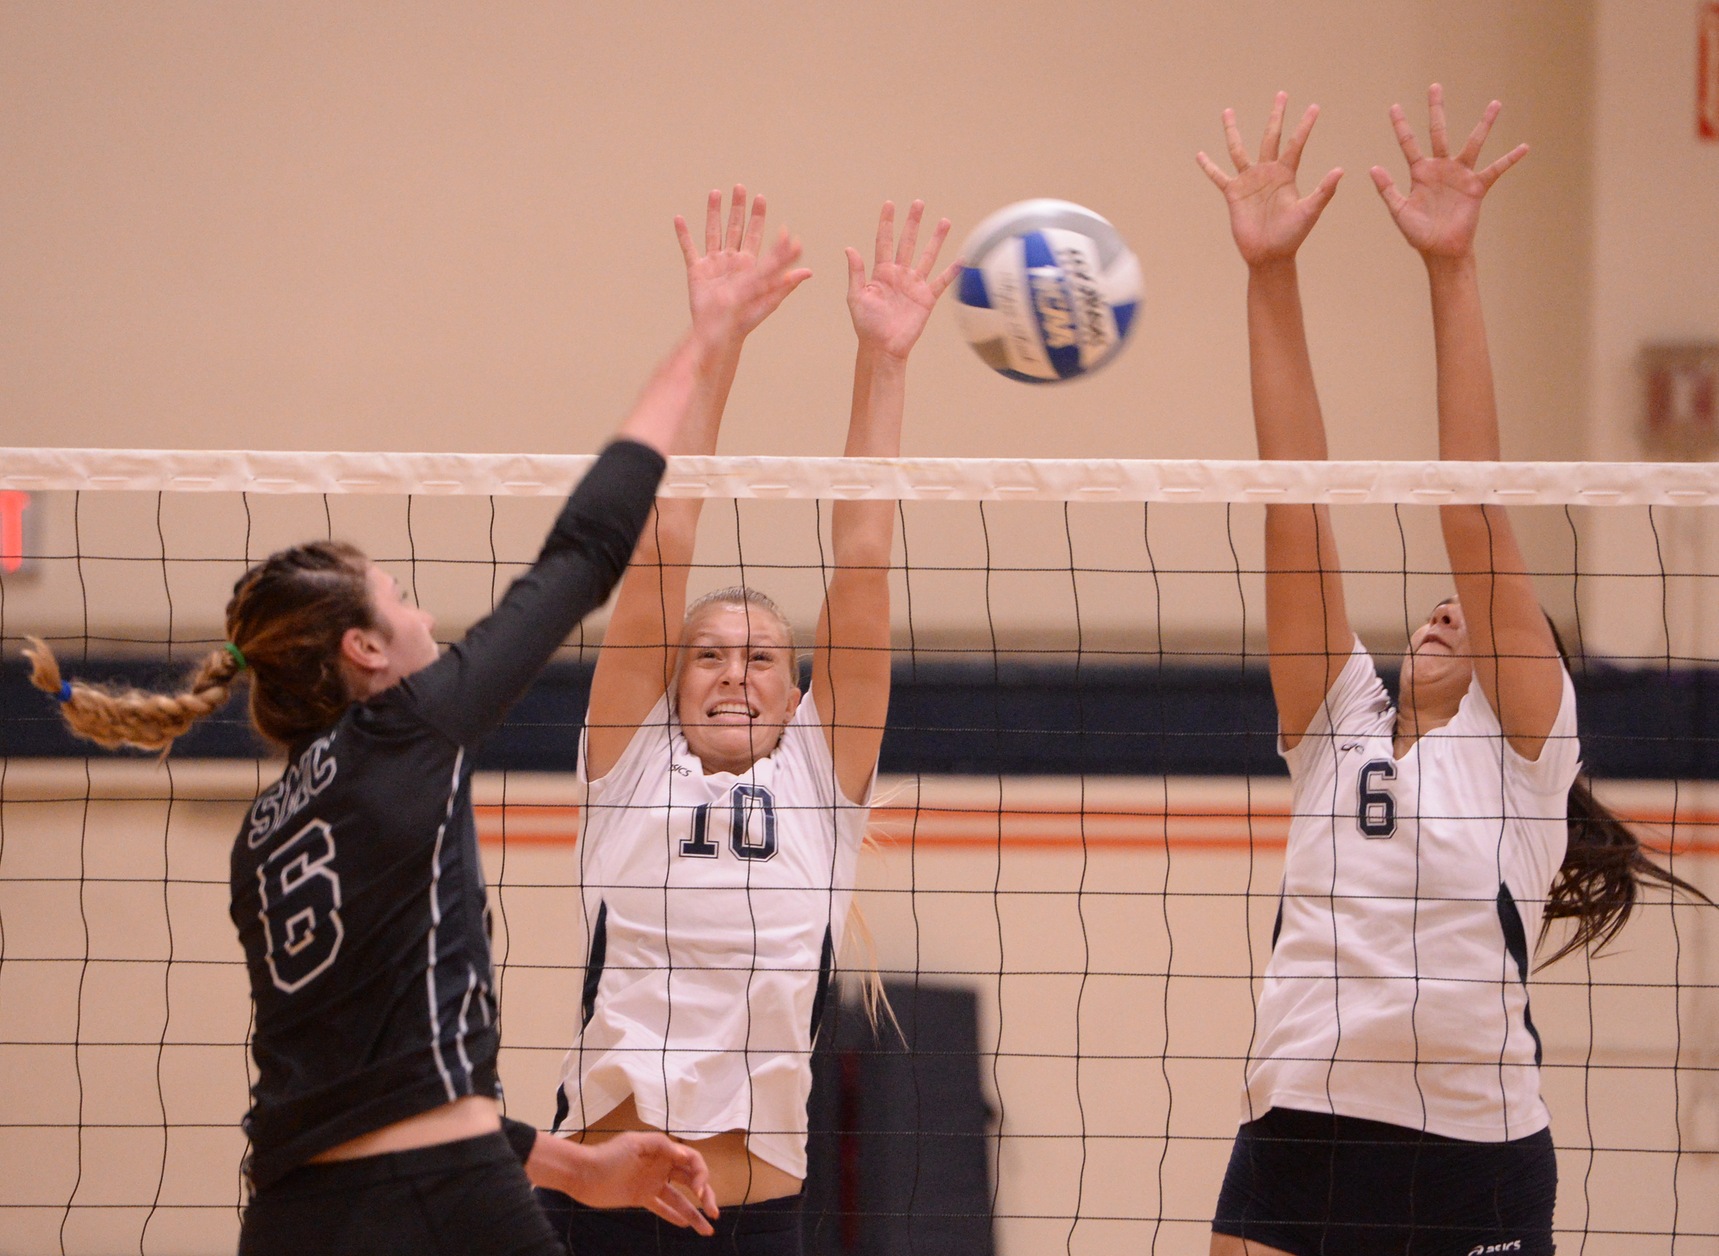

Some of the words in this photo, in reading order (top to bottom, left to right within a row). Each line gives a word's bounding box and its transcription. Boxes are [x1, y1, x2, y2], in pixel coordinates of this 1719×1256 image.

[679, 783, 778, 862] 10
[1356, 758, 1397, 839] 6
[257, 818, 344, 994] 6
